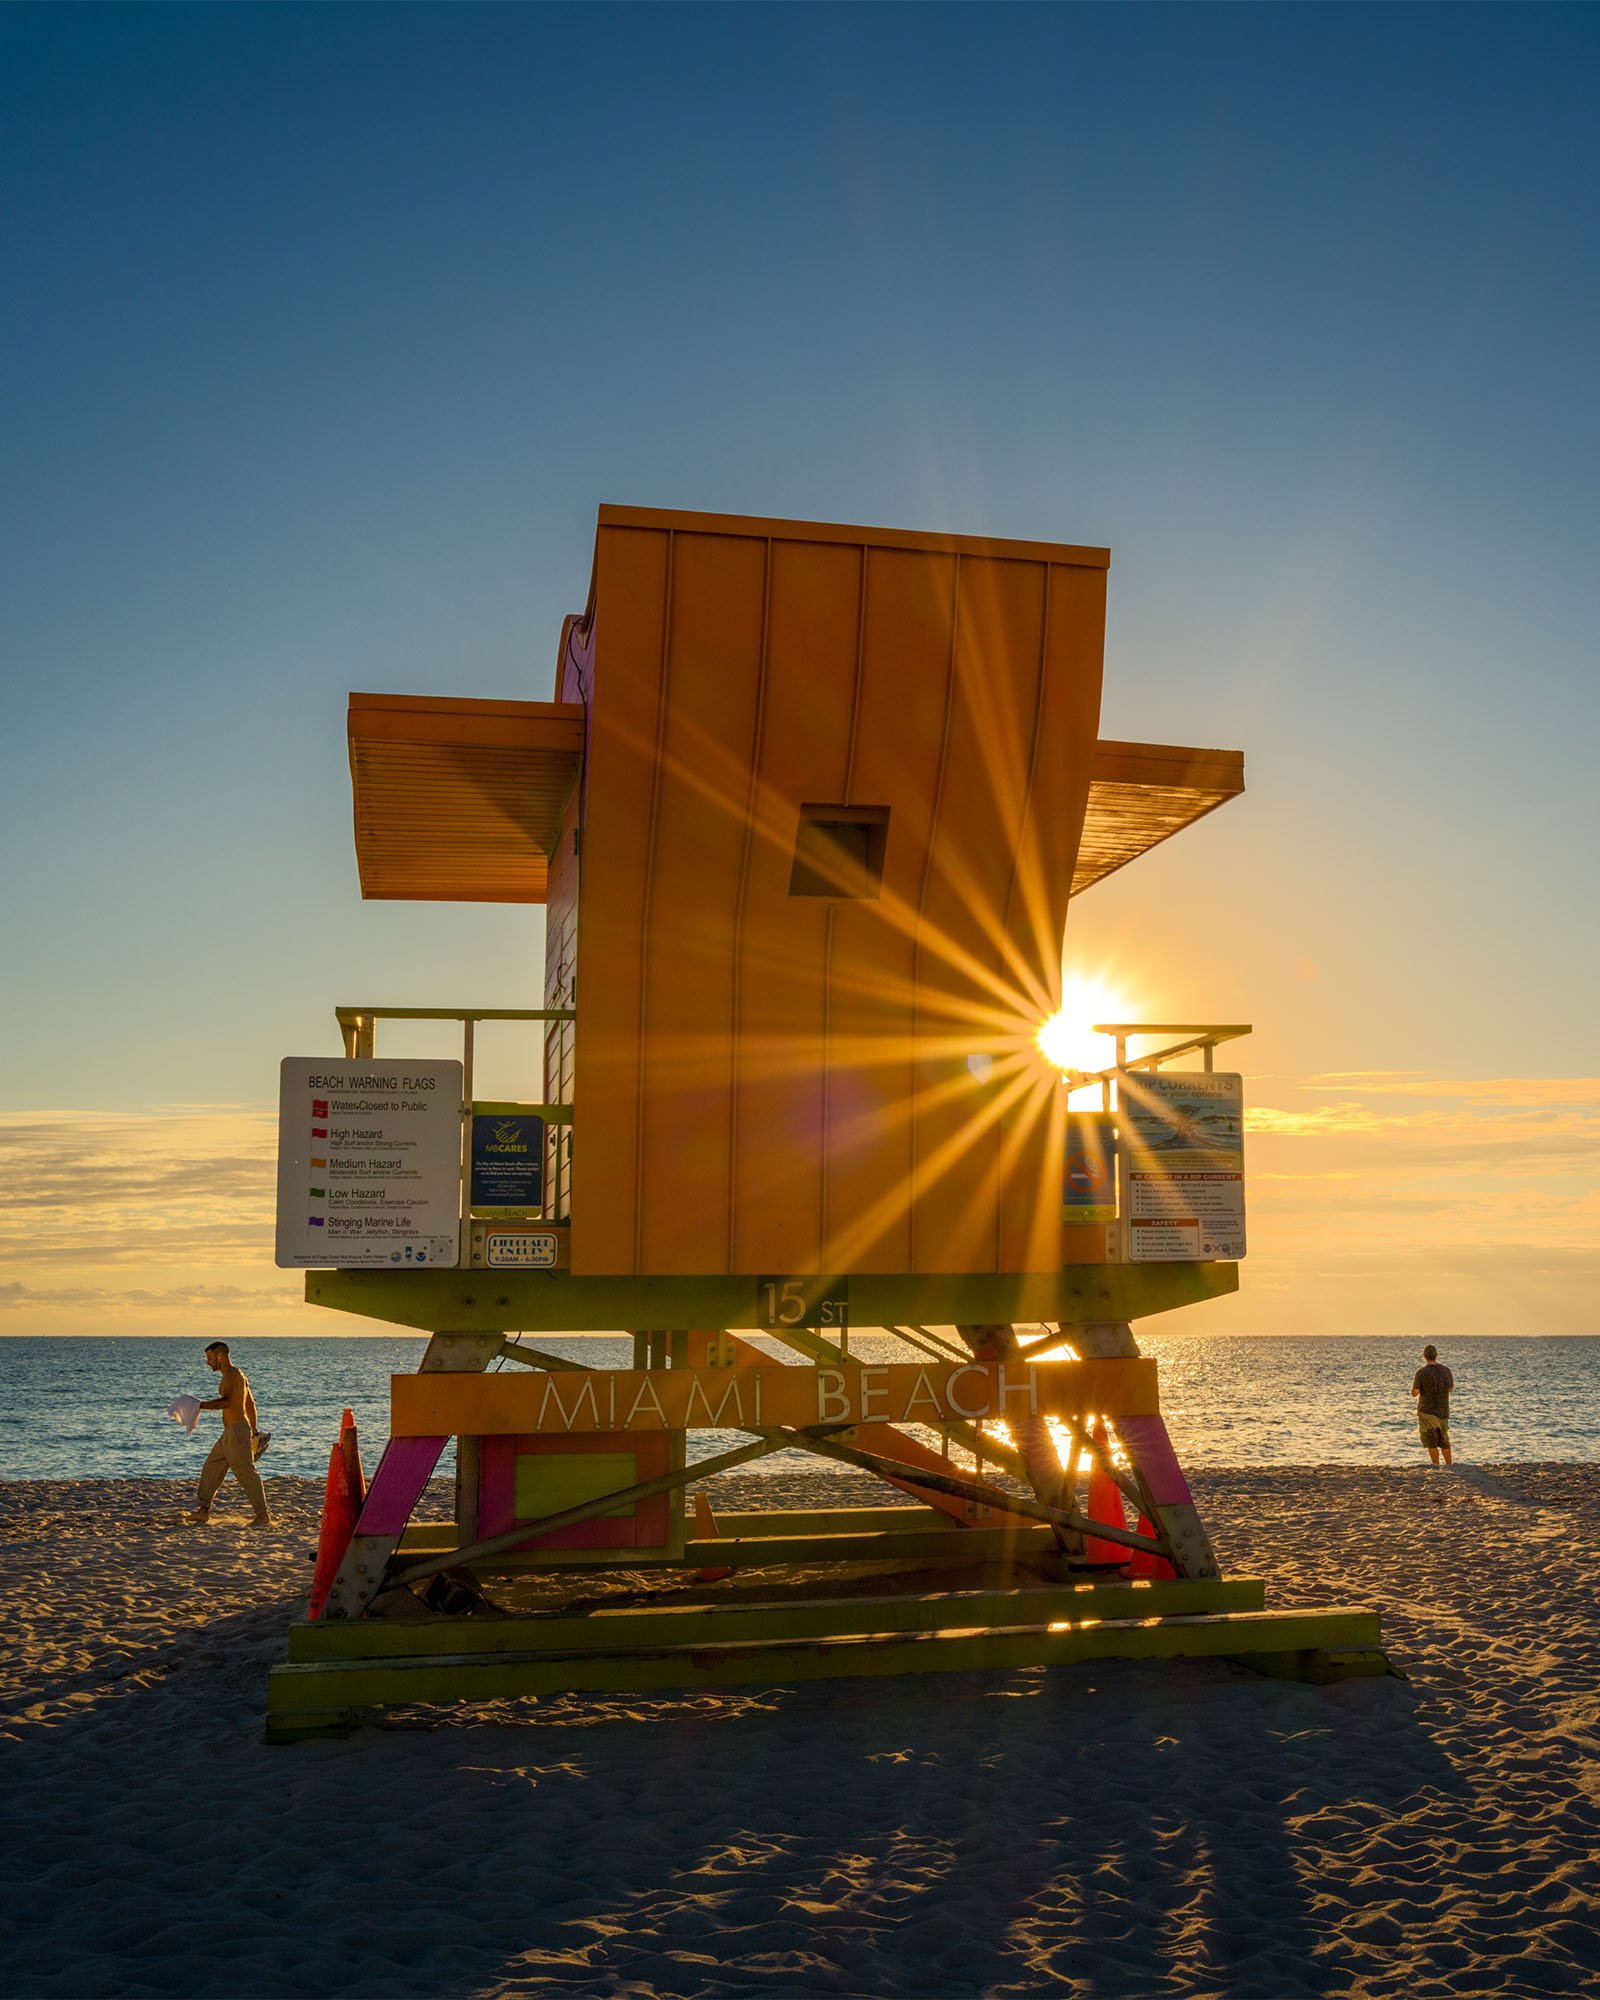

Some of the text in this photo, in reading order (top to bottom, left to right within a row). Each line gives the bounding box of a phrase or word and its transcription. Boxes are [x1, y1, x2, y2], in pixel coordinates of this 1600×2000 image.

[308, 1076, 436, 1090] BEACH WARNING FLAGS
[330, 1101, 428, 1112] Water Closed to Public
[330, 1128, 383, 1140] High Hazard
[485, 1144, 528, 1152] MBCARES
[329, 1159, 402, 1168] Medium Hazard
[328, 1188, 386, 1198] Low Hazard
[328, 1216, 411, 1229] Stinging Marine Life
[763, 1282, 848, 1324] 15 ST
[536, 1364, 1038, 1430] MIAMI BEACH
